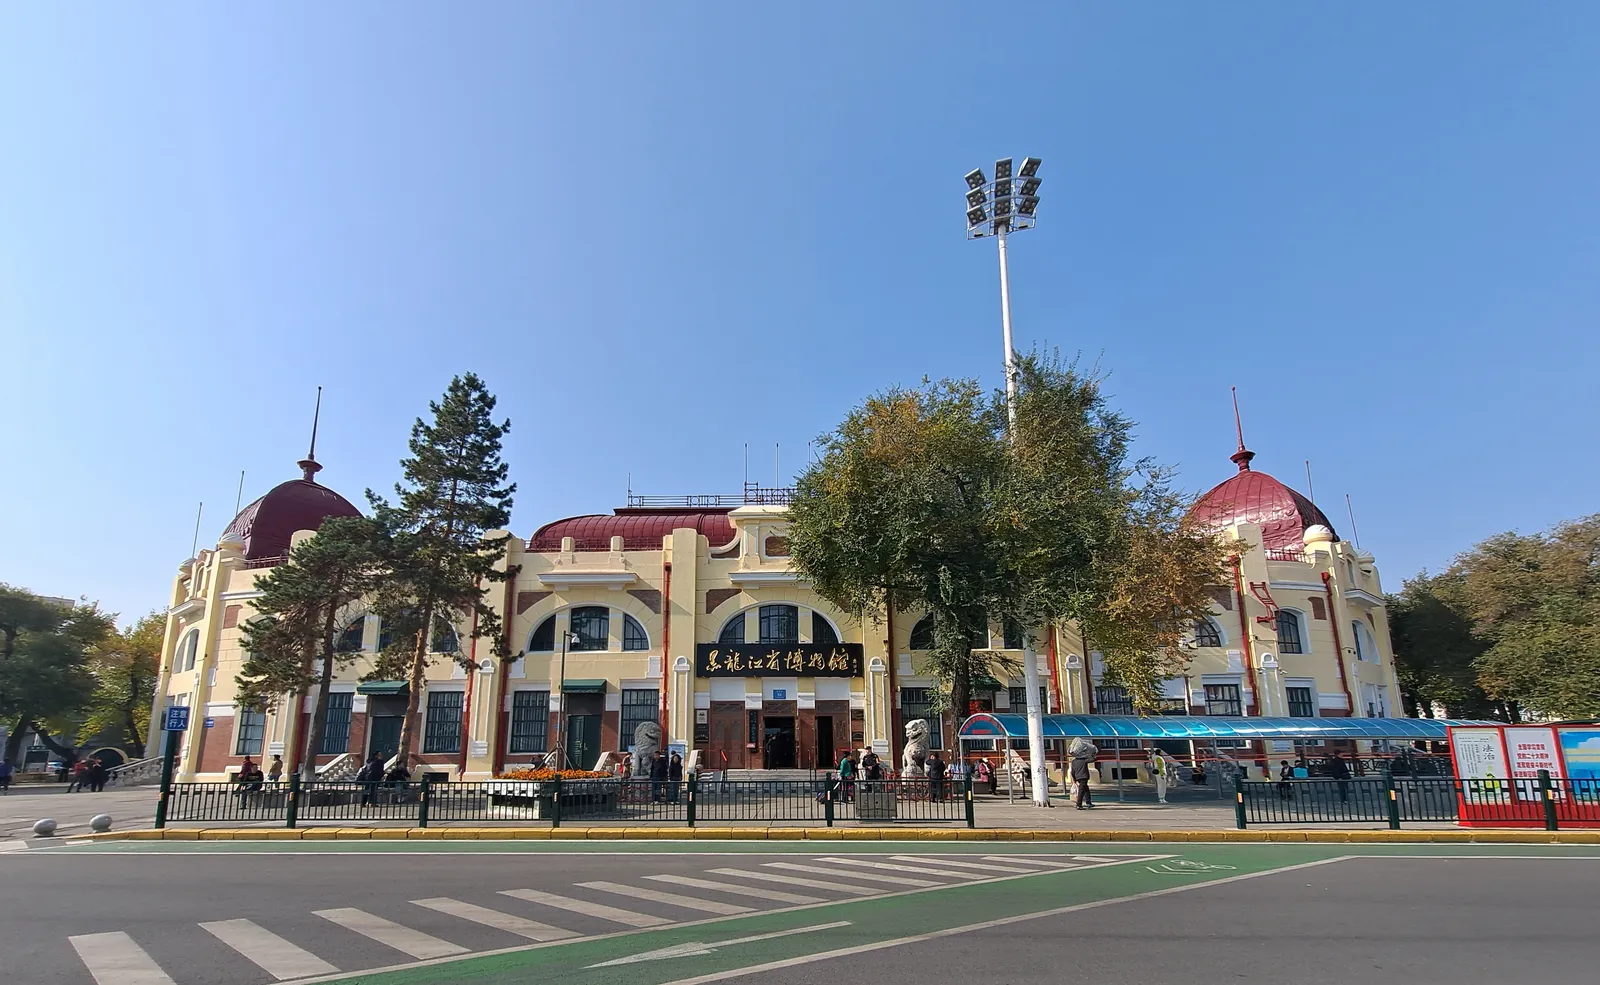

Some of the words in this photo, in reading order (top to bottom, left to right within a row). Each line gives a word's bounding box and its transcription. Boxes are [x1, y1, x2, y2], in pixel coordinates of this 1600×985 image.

[170, 709, 188, 718] 注意
[169, 719, 186, 728] 行人
[1482, 744, 1495, 760] 法治
